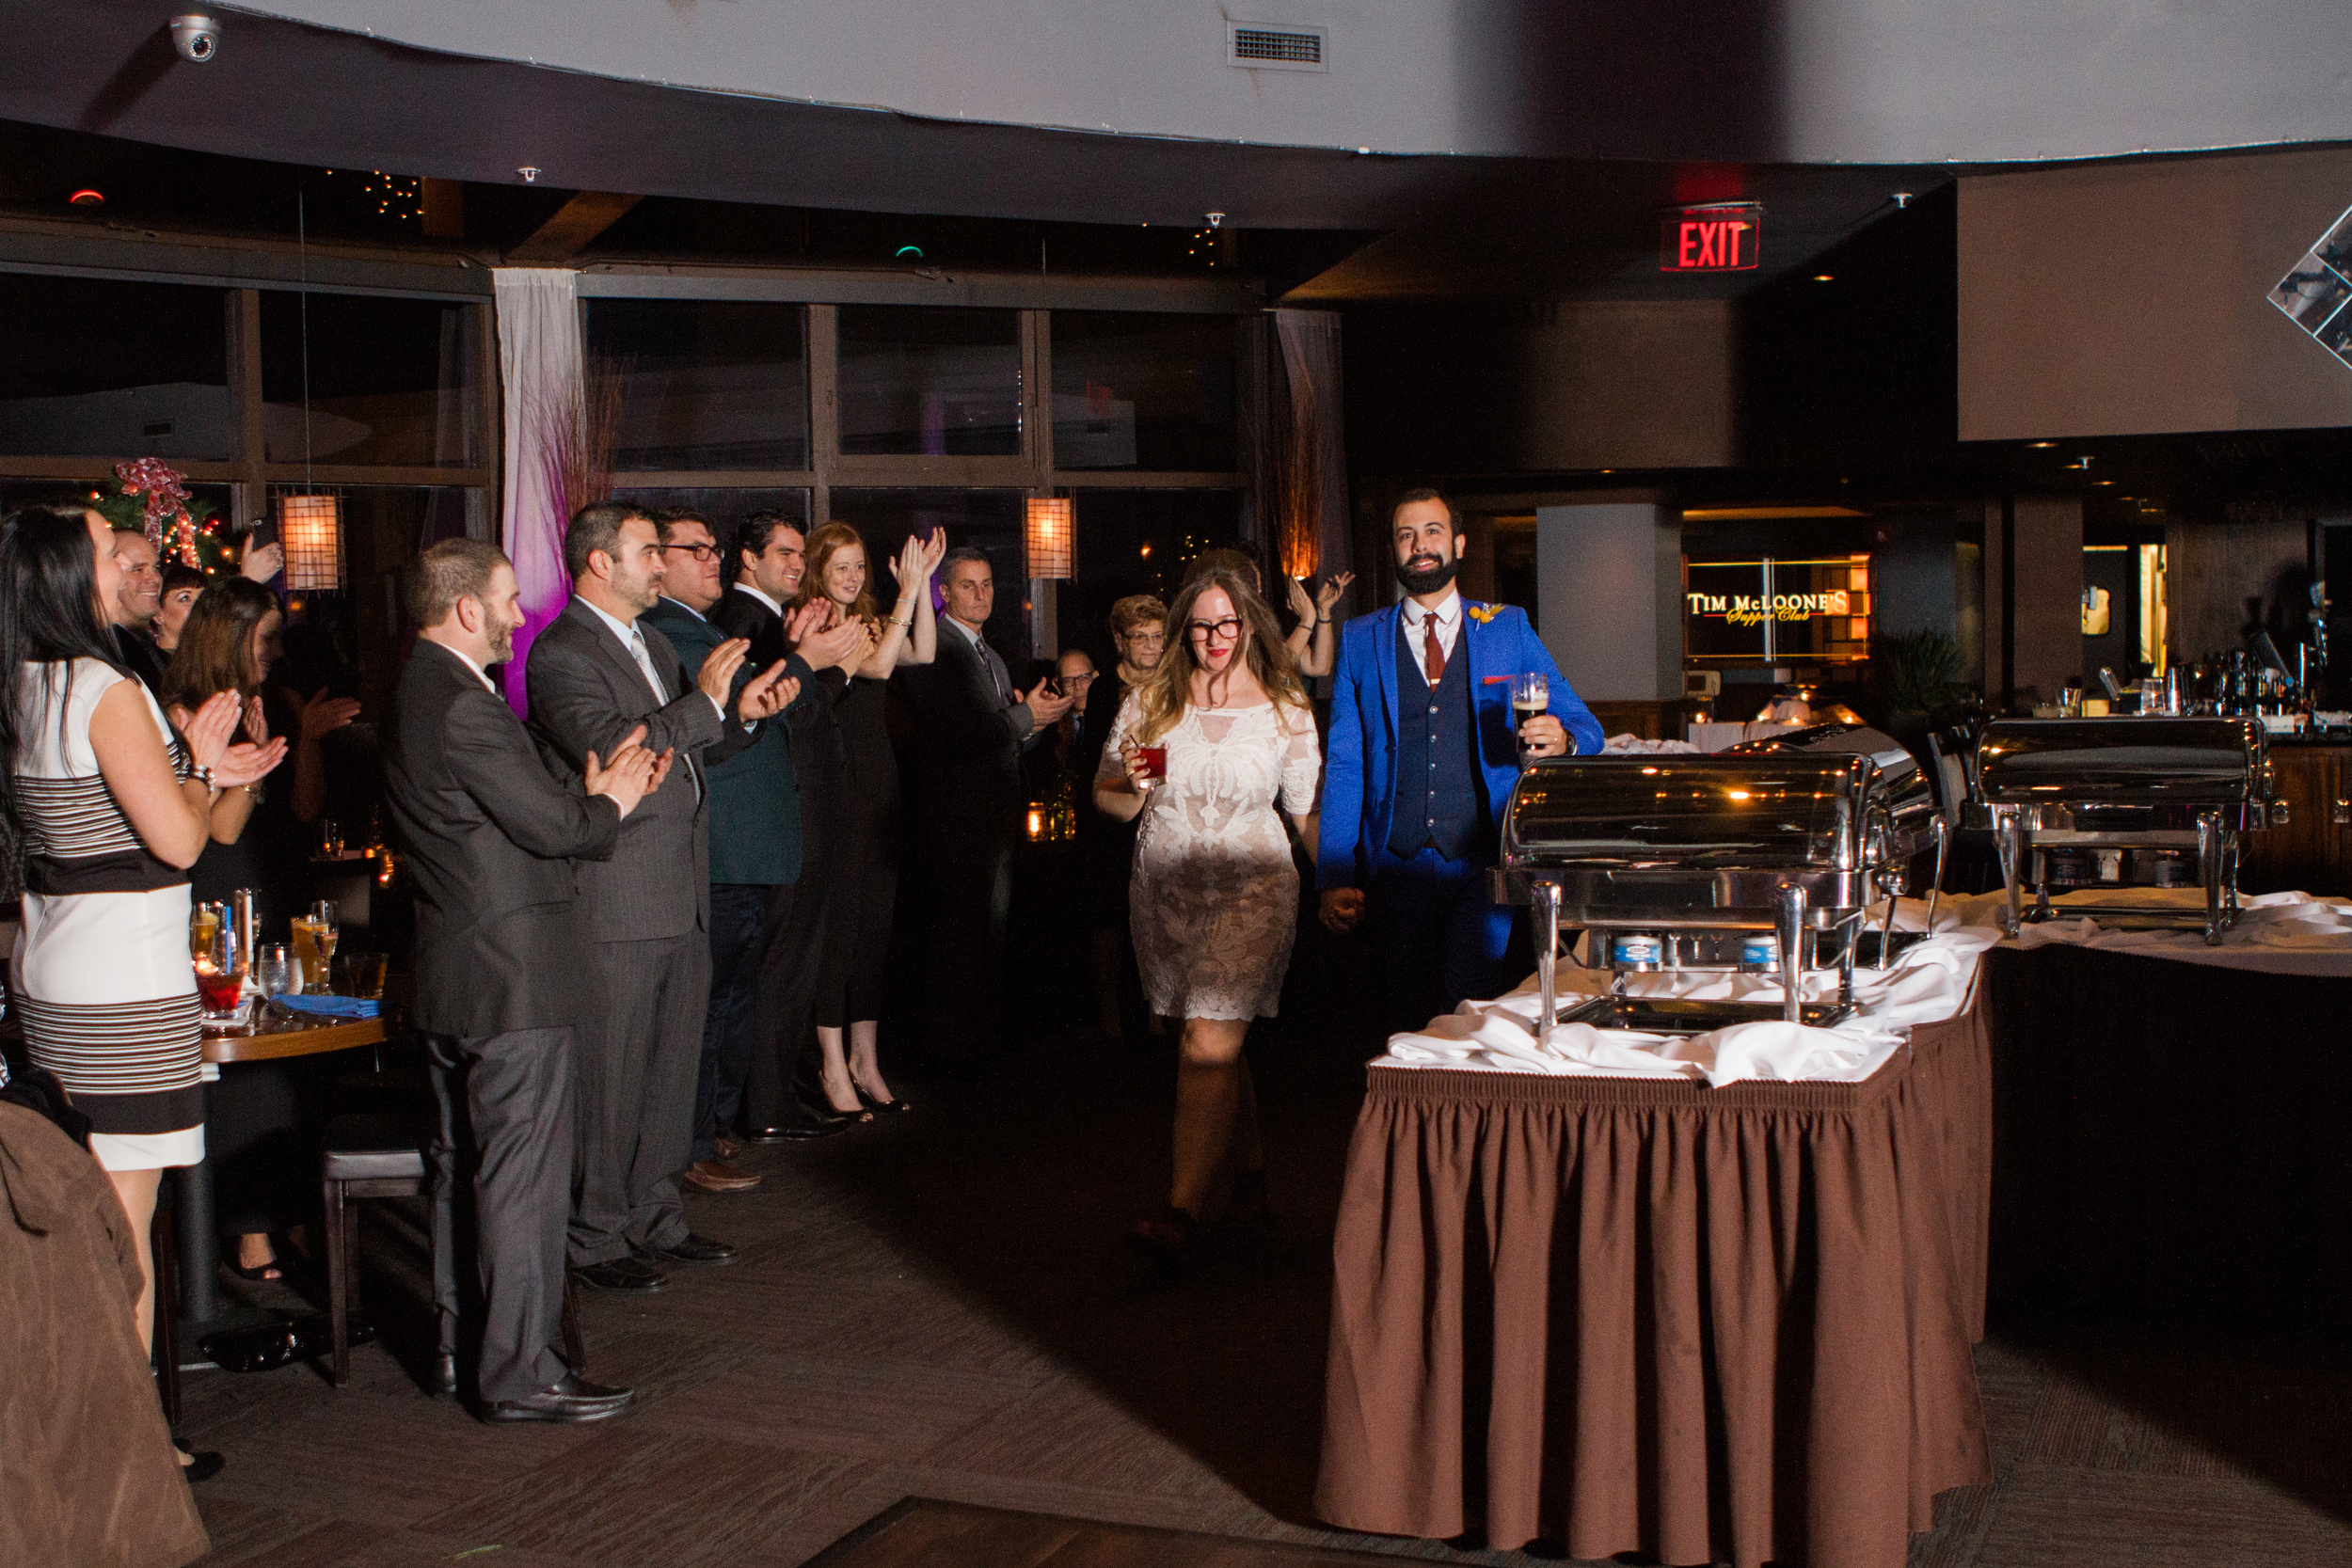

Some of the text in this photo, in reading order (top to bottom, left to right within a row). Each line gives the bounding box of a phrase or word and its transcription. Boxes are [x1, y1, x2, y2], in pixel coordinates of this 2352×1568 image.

[1679, 221, 1745, 267] EXIT
[1688, 593, 1727, 614] TIM
[1725, 605, 1810, 626] Supper Club
